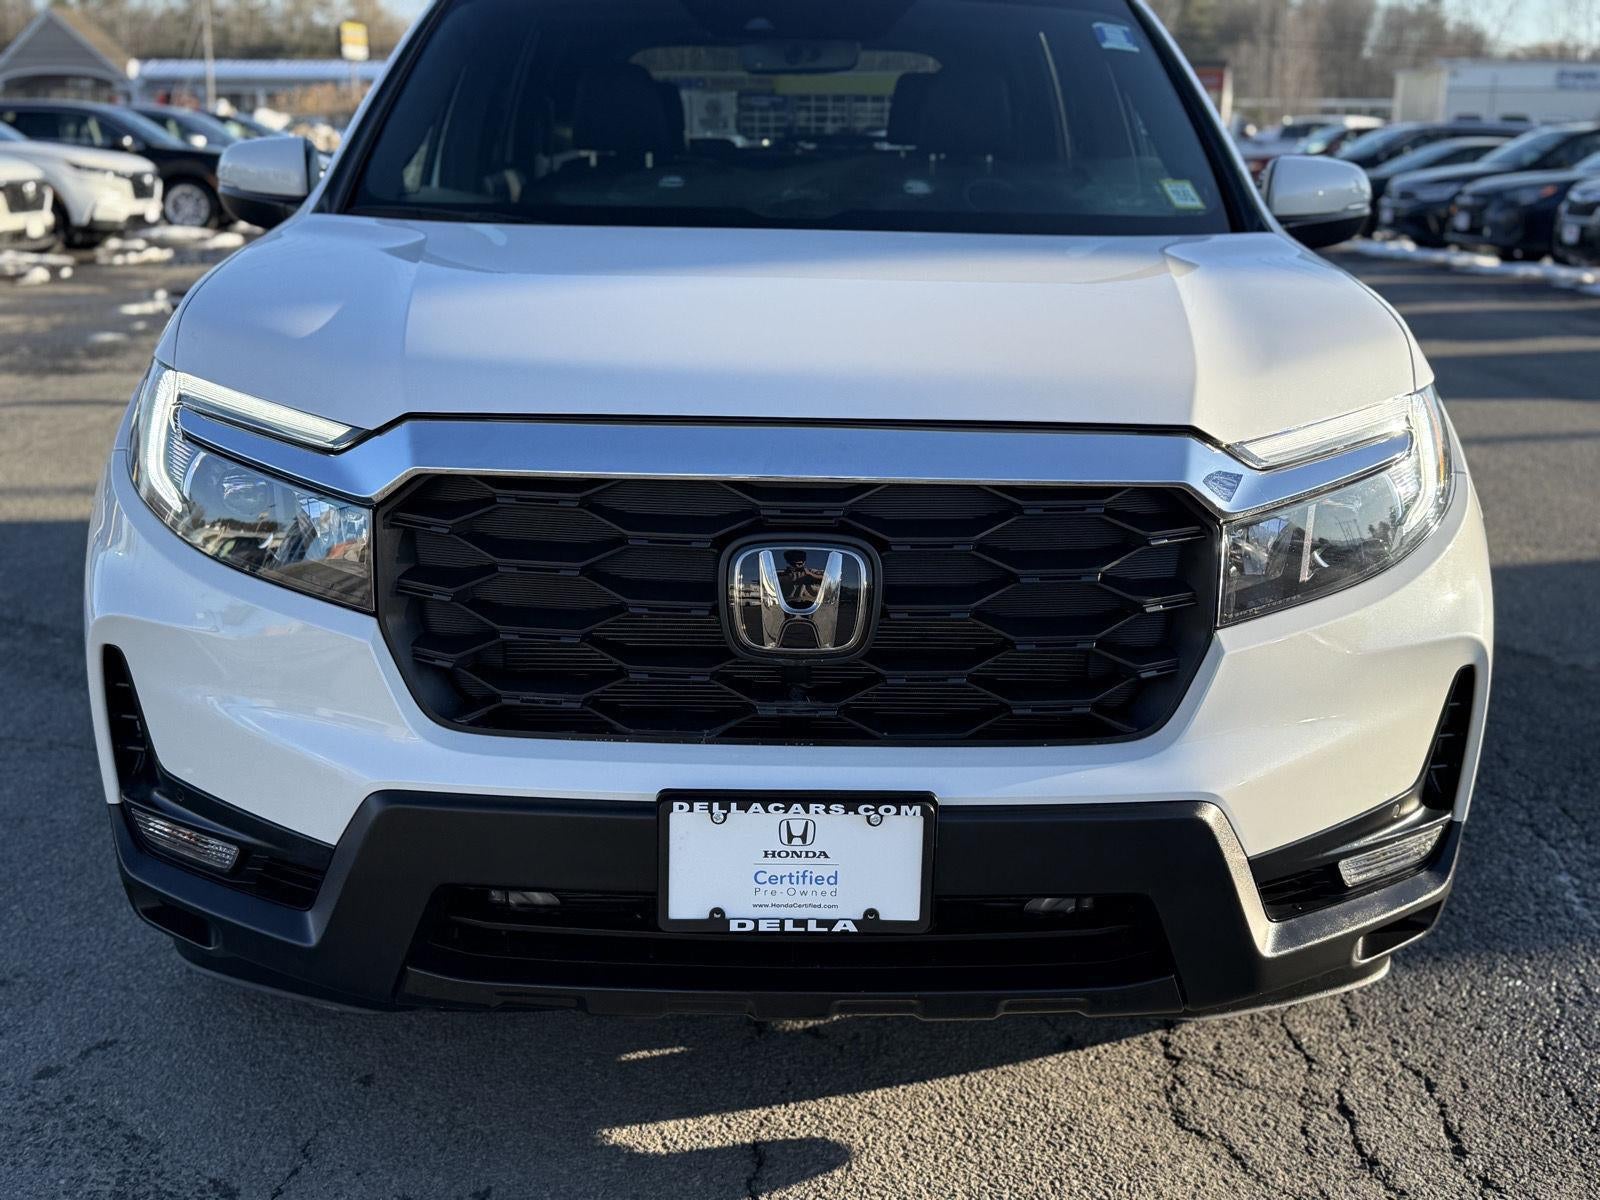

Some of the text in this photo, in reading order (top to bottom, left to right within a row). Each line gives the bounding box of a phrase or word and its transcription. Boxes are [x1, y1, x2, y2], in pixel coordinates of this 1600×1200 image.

[672, 801, 922, 816] DELLACARS.COM
[763, 850, 831, 859] HONDA
[753, 870, 839, 886] Certified
[753, 887, 838, 897] Pre-Owned
[729, 919, 858, 932] DELLA
